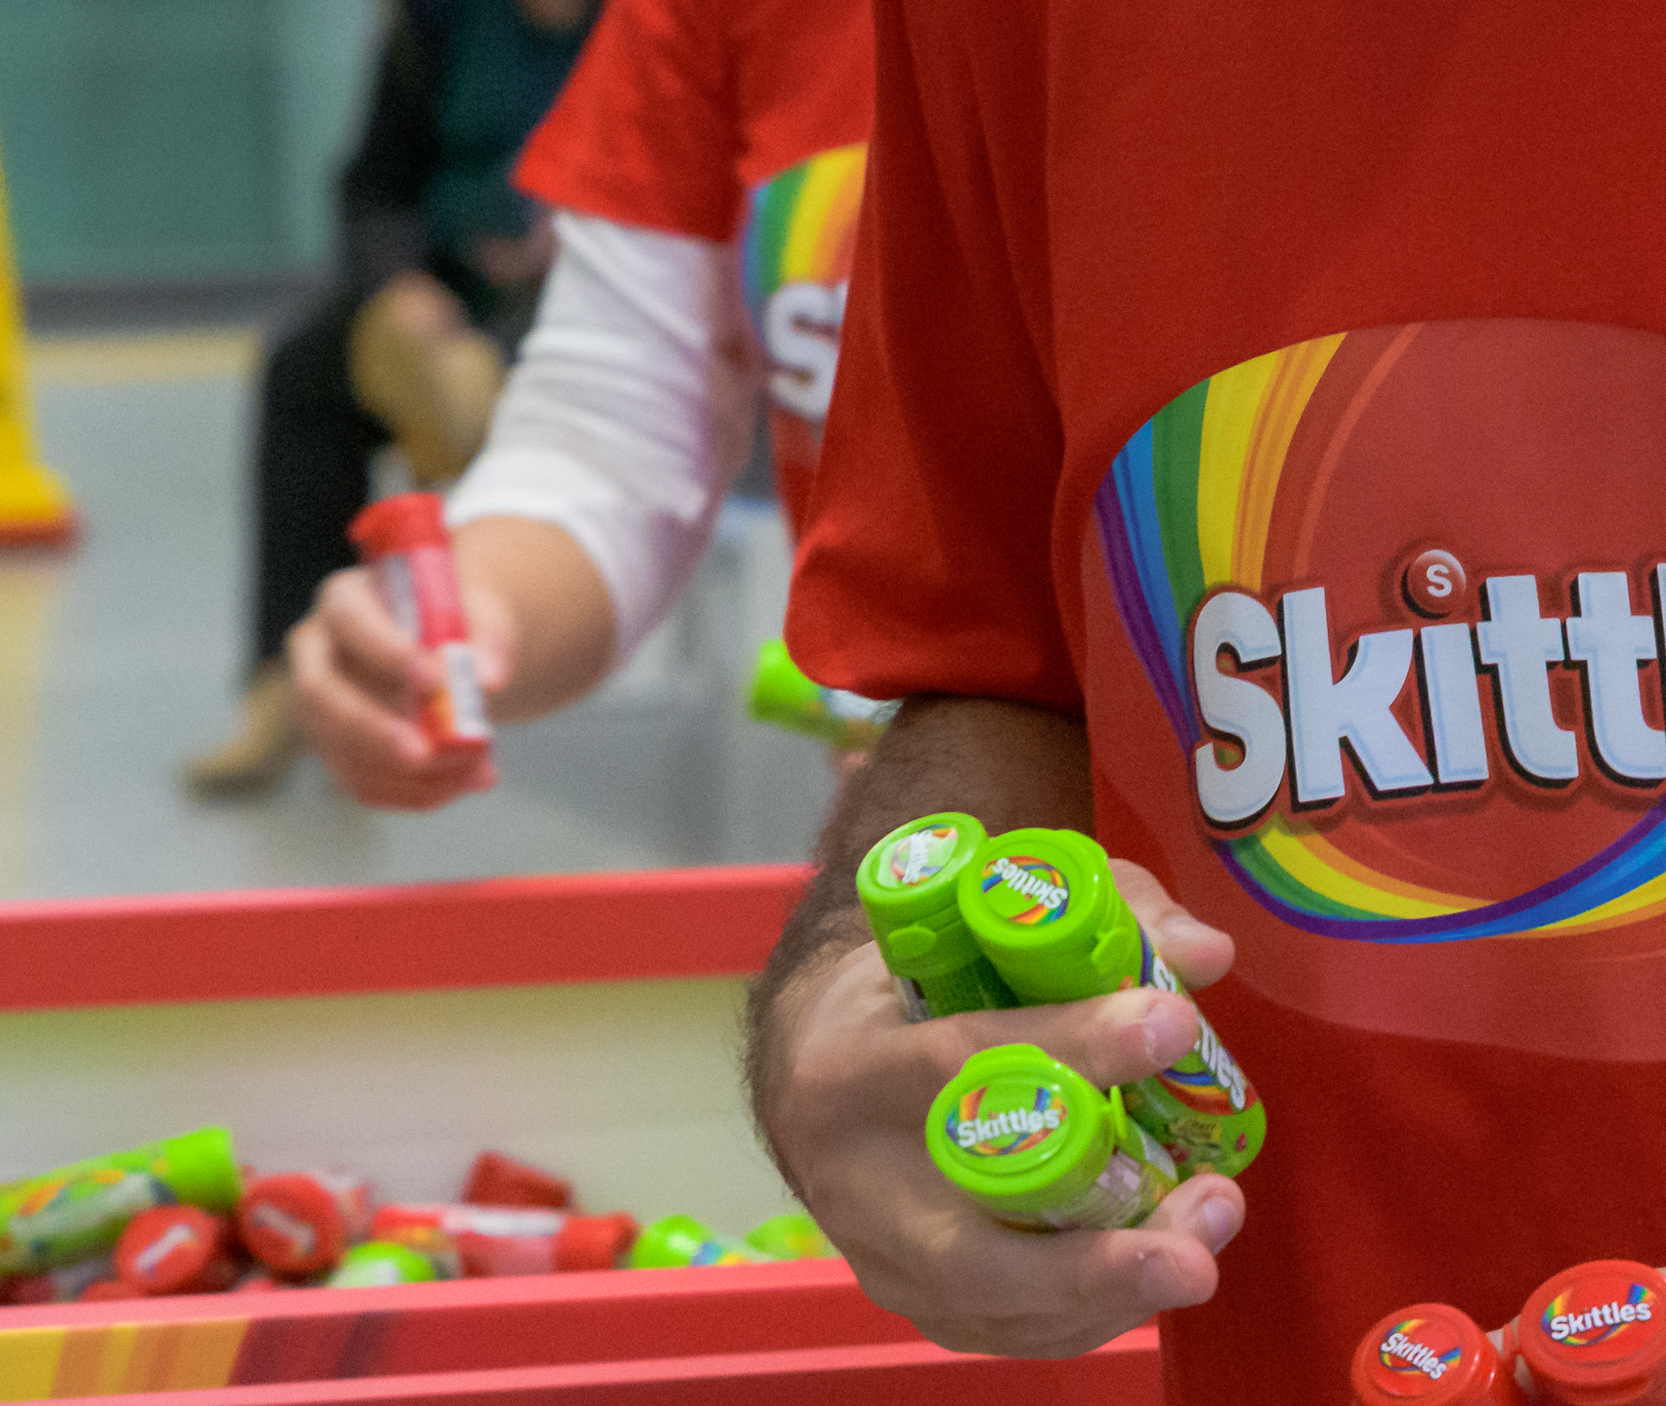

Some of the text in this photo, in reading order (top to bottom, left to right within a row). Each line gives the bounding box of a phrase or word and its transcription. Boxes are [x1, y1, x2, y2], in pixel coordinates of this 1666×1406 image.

[992, 856, 1069, 910] Skittles
[956, 1107, 1061, 1149] Skittles
[1550, 1301, 1652, 1341] Skittles
[1380, 1332, 1448, 1380] Skittles
